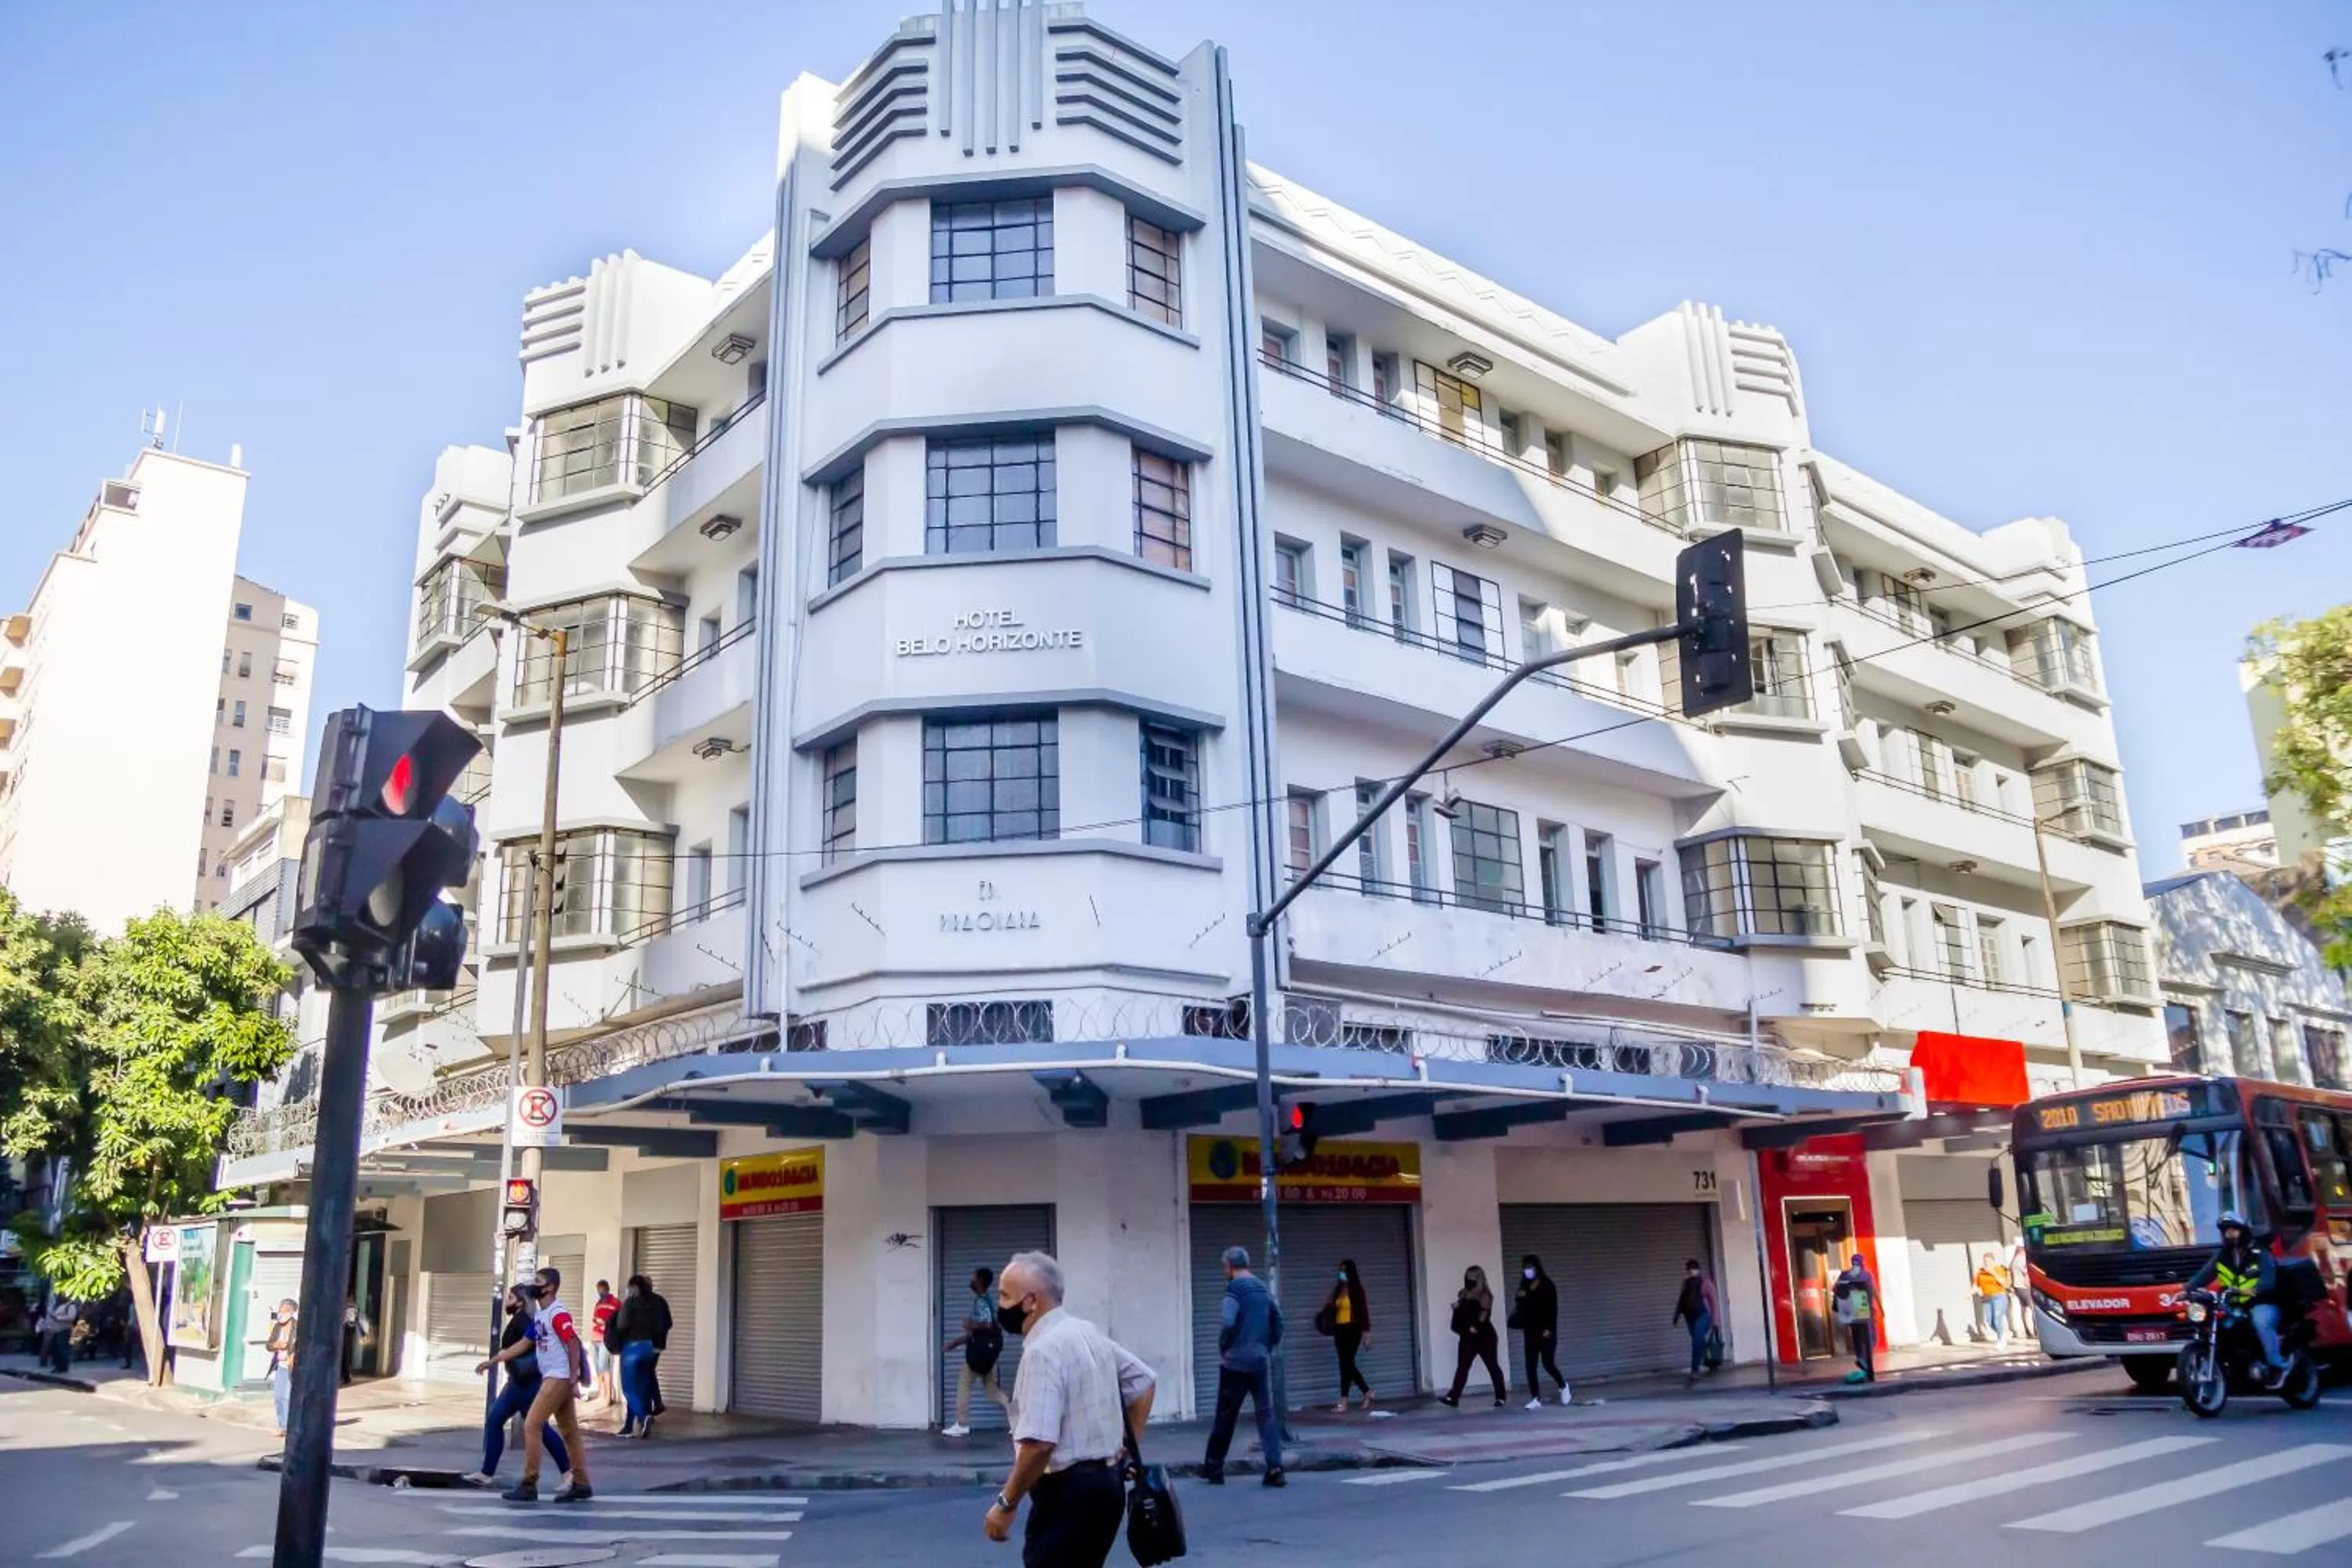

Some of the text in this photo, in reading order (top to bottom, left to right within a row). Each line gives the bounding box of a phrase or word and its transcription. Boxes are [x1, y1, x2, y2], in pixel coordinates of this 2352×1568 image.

[954, 609, 1025, 630] HOTEL
[896, 630, 1083, 657] BELO HORIZONTE
[1693, 1171, 1717, 1189] 731
[2066, 1298, 2131, 1310] ELEVADOR
